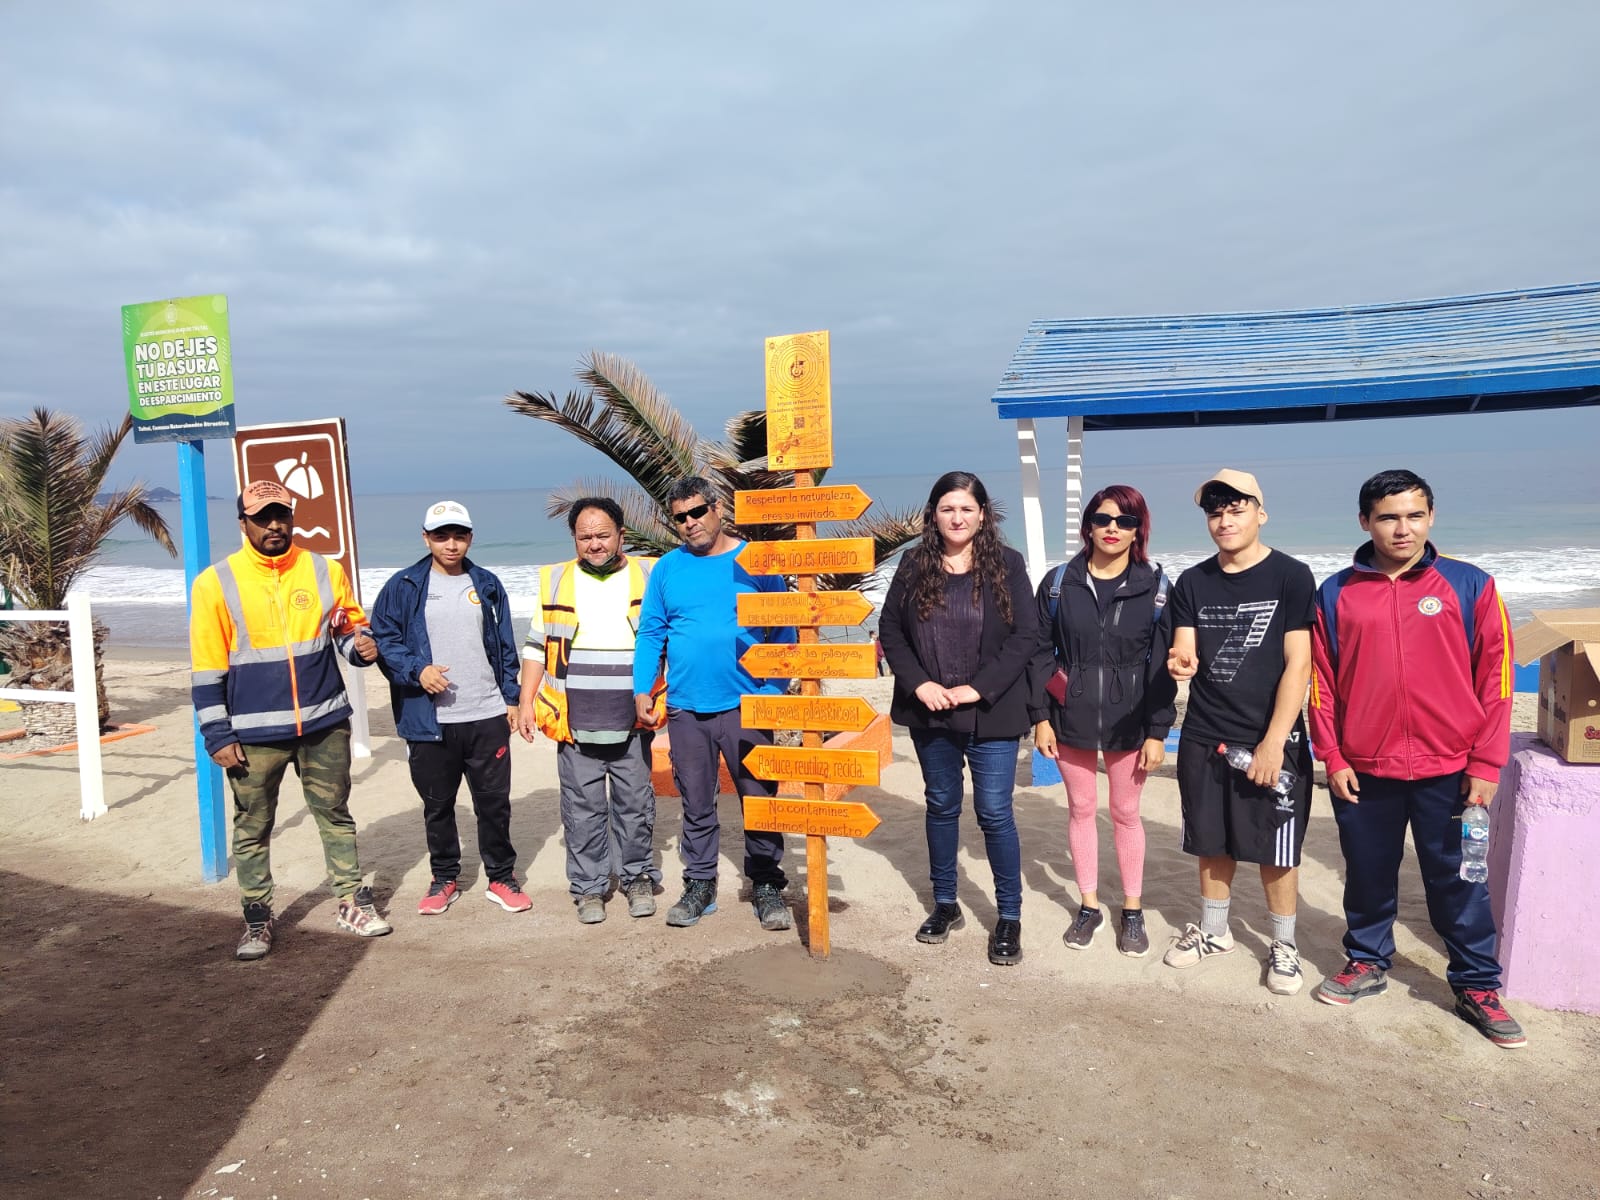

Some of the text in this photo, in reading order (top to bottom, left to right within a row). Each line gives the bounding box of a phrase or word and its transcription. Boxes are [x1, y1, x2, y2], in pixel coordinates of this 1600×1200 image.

[135, 336, 218, 362] NO DEJES
[136, 358, 220, 379] TU BASURA
[138, 375, 221, 394] EN ESTE LUGAR
[140, 391, 222, 407] DE ESPARCIMIENTO
[746, 490, 854, 506] Respetar la naturaleza,
[762, 506, 837, 521] eres su invitado.
[750, 550, 760, 568] La
[762, 552, 786, 568] arena
[790, 551, 802, 567] no
[806, 552, 816, 568] es
[805, 647, 818, 658] la
[822, 648, 863, 662] playa,
[787, 666, 802, 676] de
[758, 754, 792, 776] Reduce,
[794, 756, 831, 779] reutiliza,
[768, 800, 785, 814] No
[754, 816, 802, 831] cuidemos
[806, 818, 816, 834] lo
